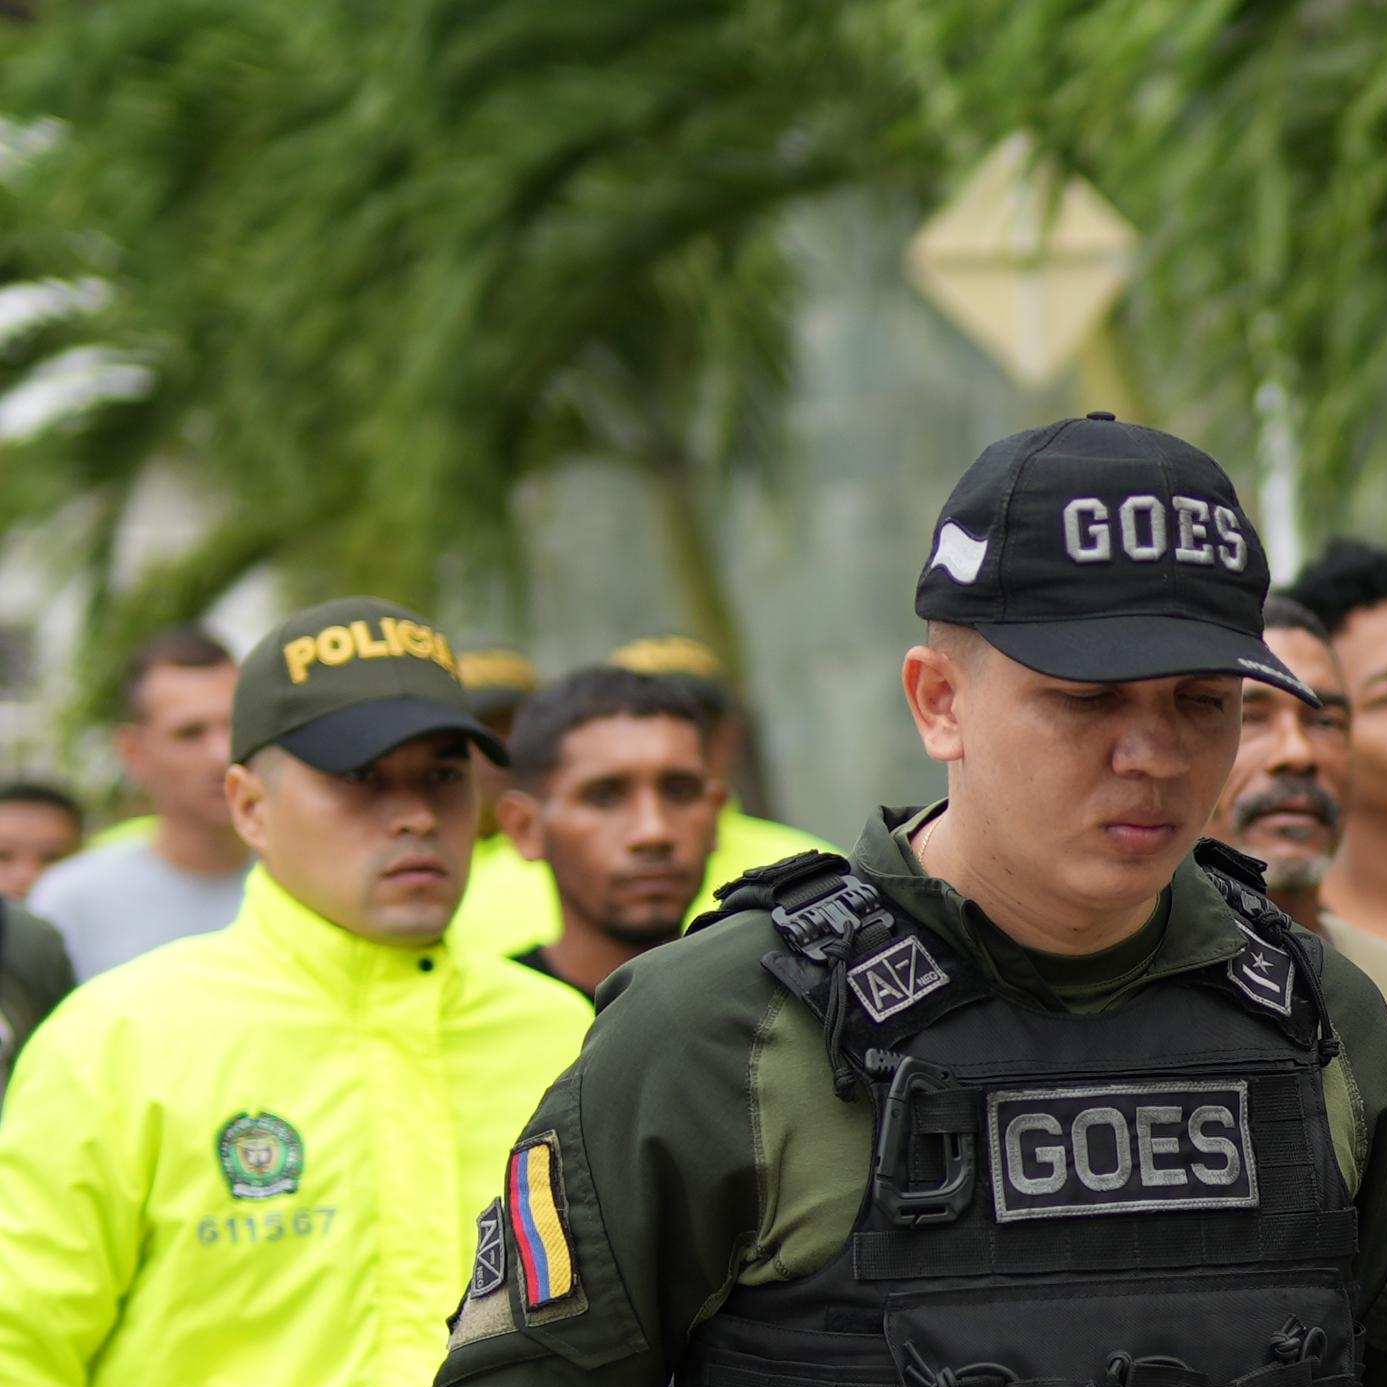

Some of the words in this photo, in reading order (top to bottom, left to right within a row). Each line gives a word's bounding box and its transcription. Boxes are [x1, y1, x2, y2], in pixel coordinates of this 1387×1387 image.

[1063, 495, 1248, 573] GOES
[1005, 1105, 1240, 1196] GOES
[197, 1206, 336, 1246] 611567
